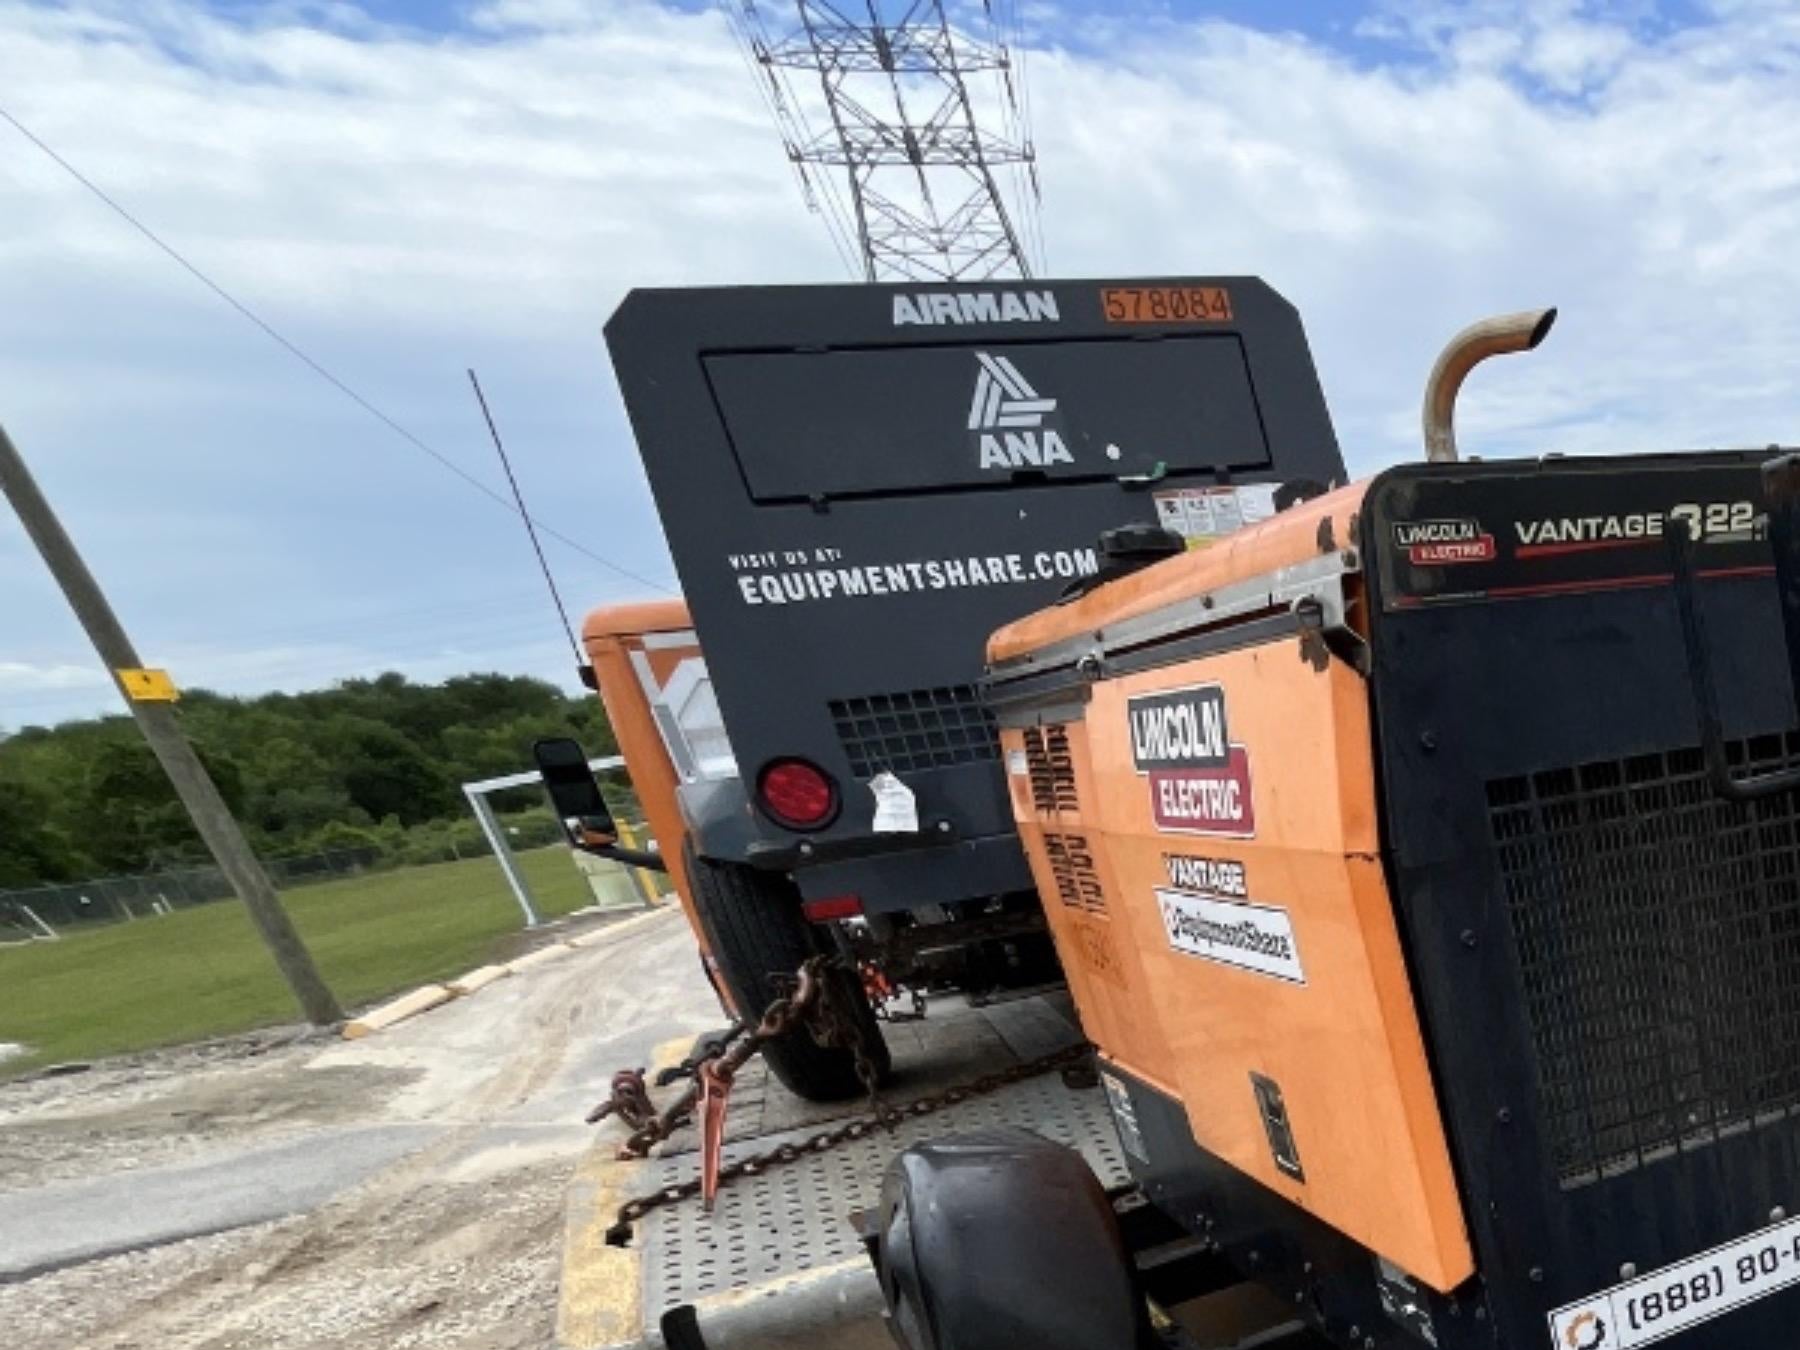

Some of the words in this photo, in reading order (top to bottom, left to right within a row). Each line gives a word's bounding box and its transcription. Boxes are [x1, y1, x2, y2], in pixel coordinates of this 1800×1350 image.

[893, 290, 1060, 325] AIRMAN
[1106, 288, 1229, 320] 578084
[979, 430, 1075, 469] ANA
[1397, 521, 1476, 545] LINCOLN
[1514, 511, 1664, 545] VANTAGE
[1420, 542, 1486, 559] ELECTRIC
[737, 547, 1099, 605] EQUIPMENTSHARE.COM
[1131, 698, 1226, 761] LINCOLN
[1157, 778, 1243, 820] ELECTRIC
[1626, 1265, 1724, 1330] (888)
